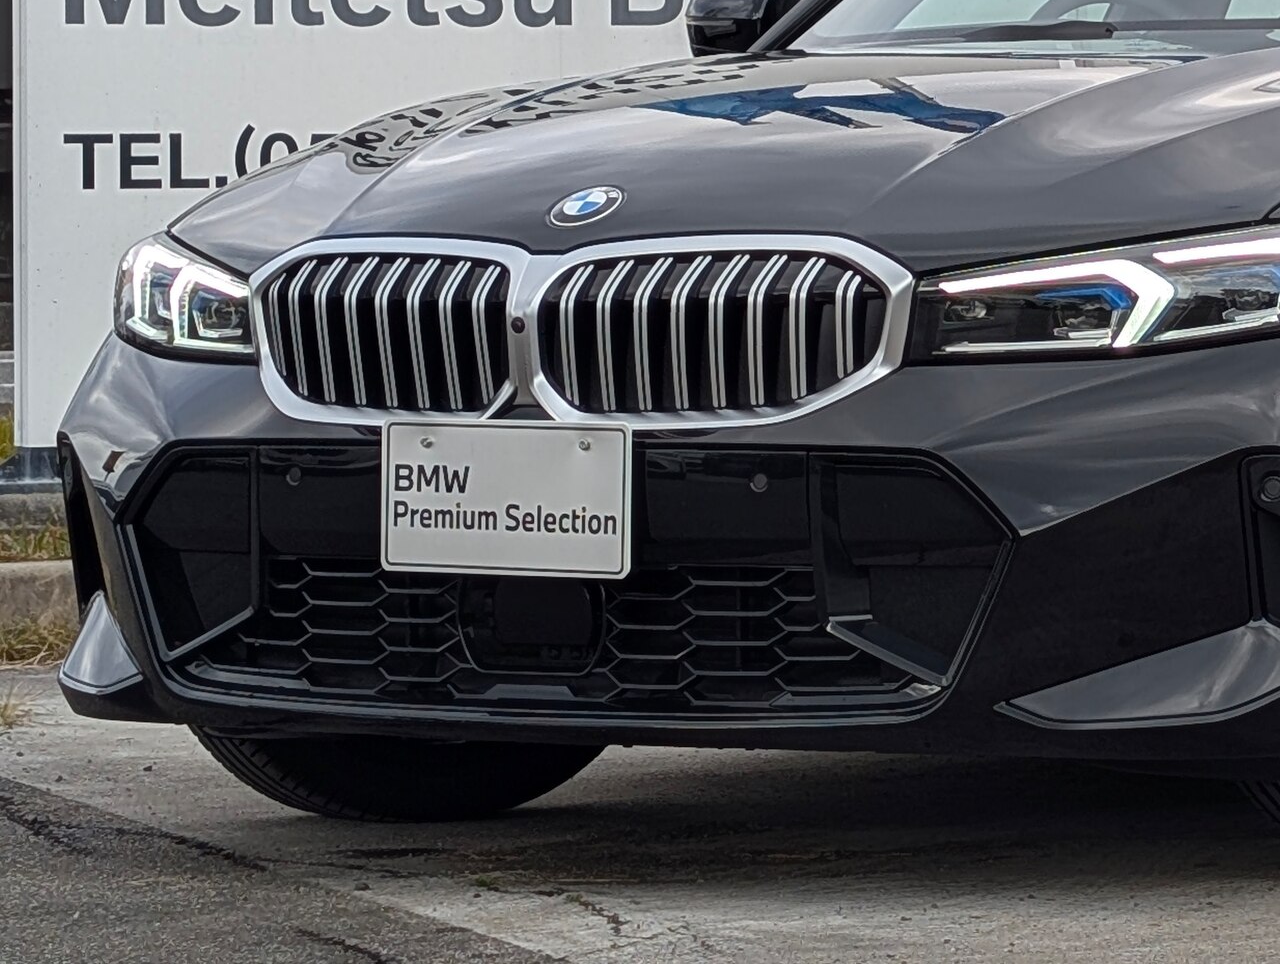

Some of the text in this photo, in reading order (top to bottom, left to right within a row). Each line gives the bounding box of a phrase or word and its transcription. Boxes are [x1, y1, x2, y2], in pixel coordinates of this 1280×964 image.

[393, 463, 470, 493] BMW
[393, 500, 617, 535] Premium Selection
